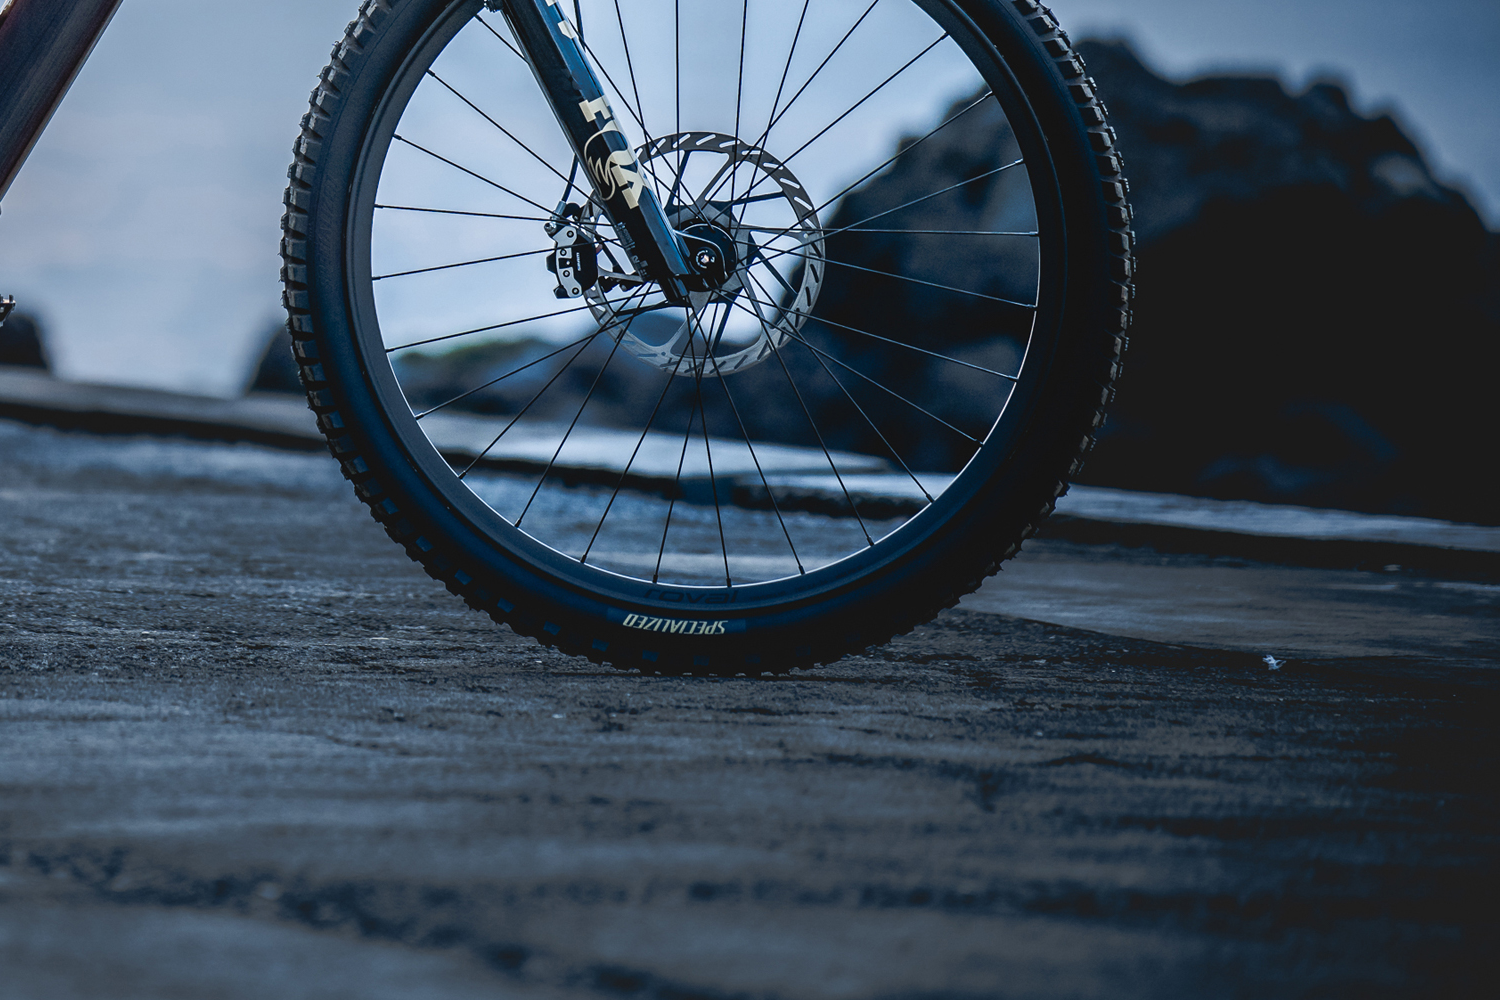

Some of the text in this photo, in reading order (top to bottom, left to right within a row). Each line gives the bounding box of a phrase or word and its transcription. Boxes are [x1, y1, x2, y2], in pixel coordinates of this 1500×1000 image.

[579, 96, 648, 209] FOX
[642, 588, 739, 605] roval
[622, 613, 729, 635] SPECIALIZED
